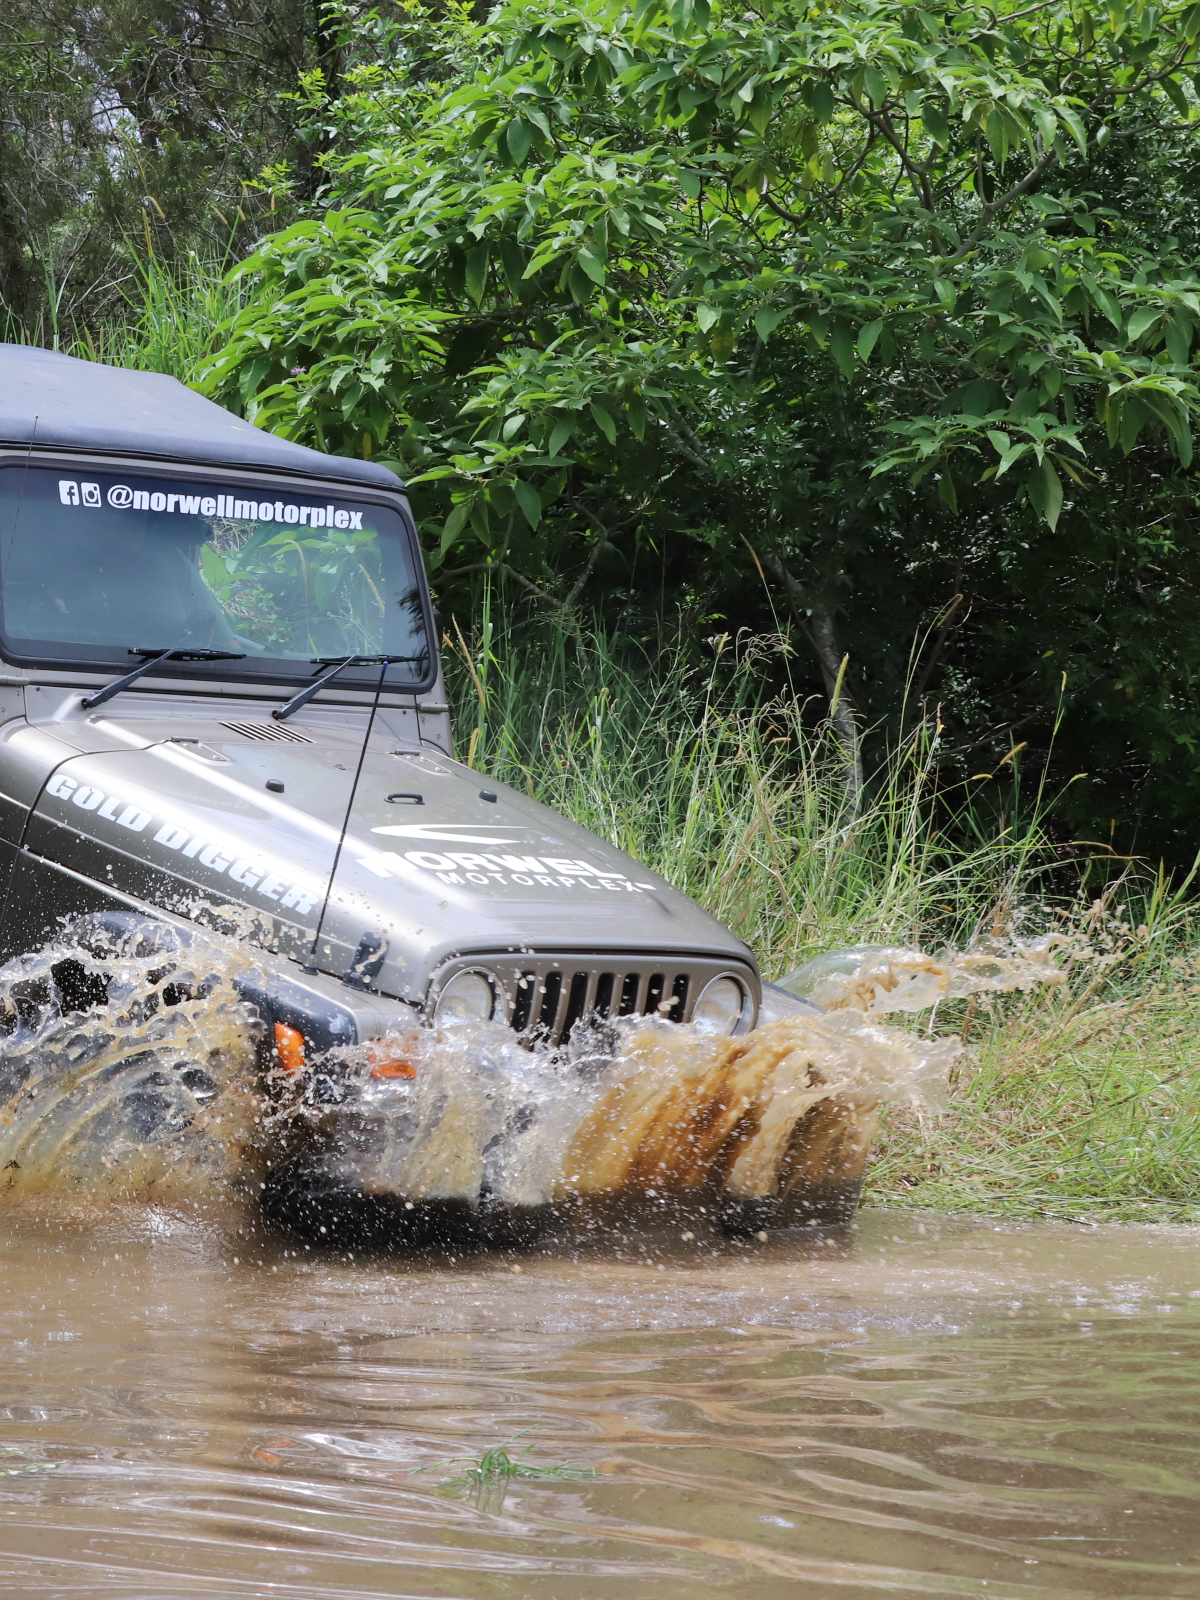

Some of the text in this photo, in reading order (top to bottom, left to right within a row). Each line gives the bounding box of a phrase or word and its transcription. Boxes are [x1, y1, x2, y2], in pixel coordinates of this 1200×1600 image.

[107, 484, 363, 531] @norwellmotorplex
[45, 774, 320, 916] GOLD DIGGER
[434, 871, 644, 893] MOTORPLEX
